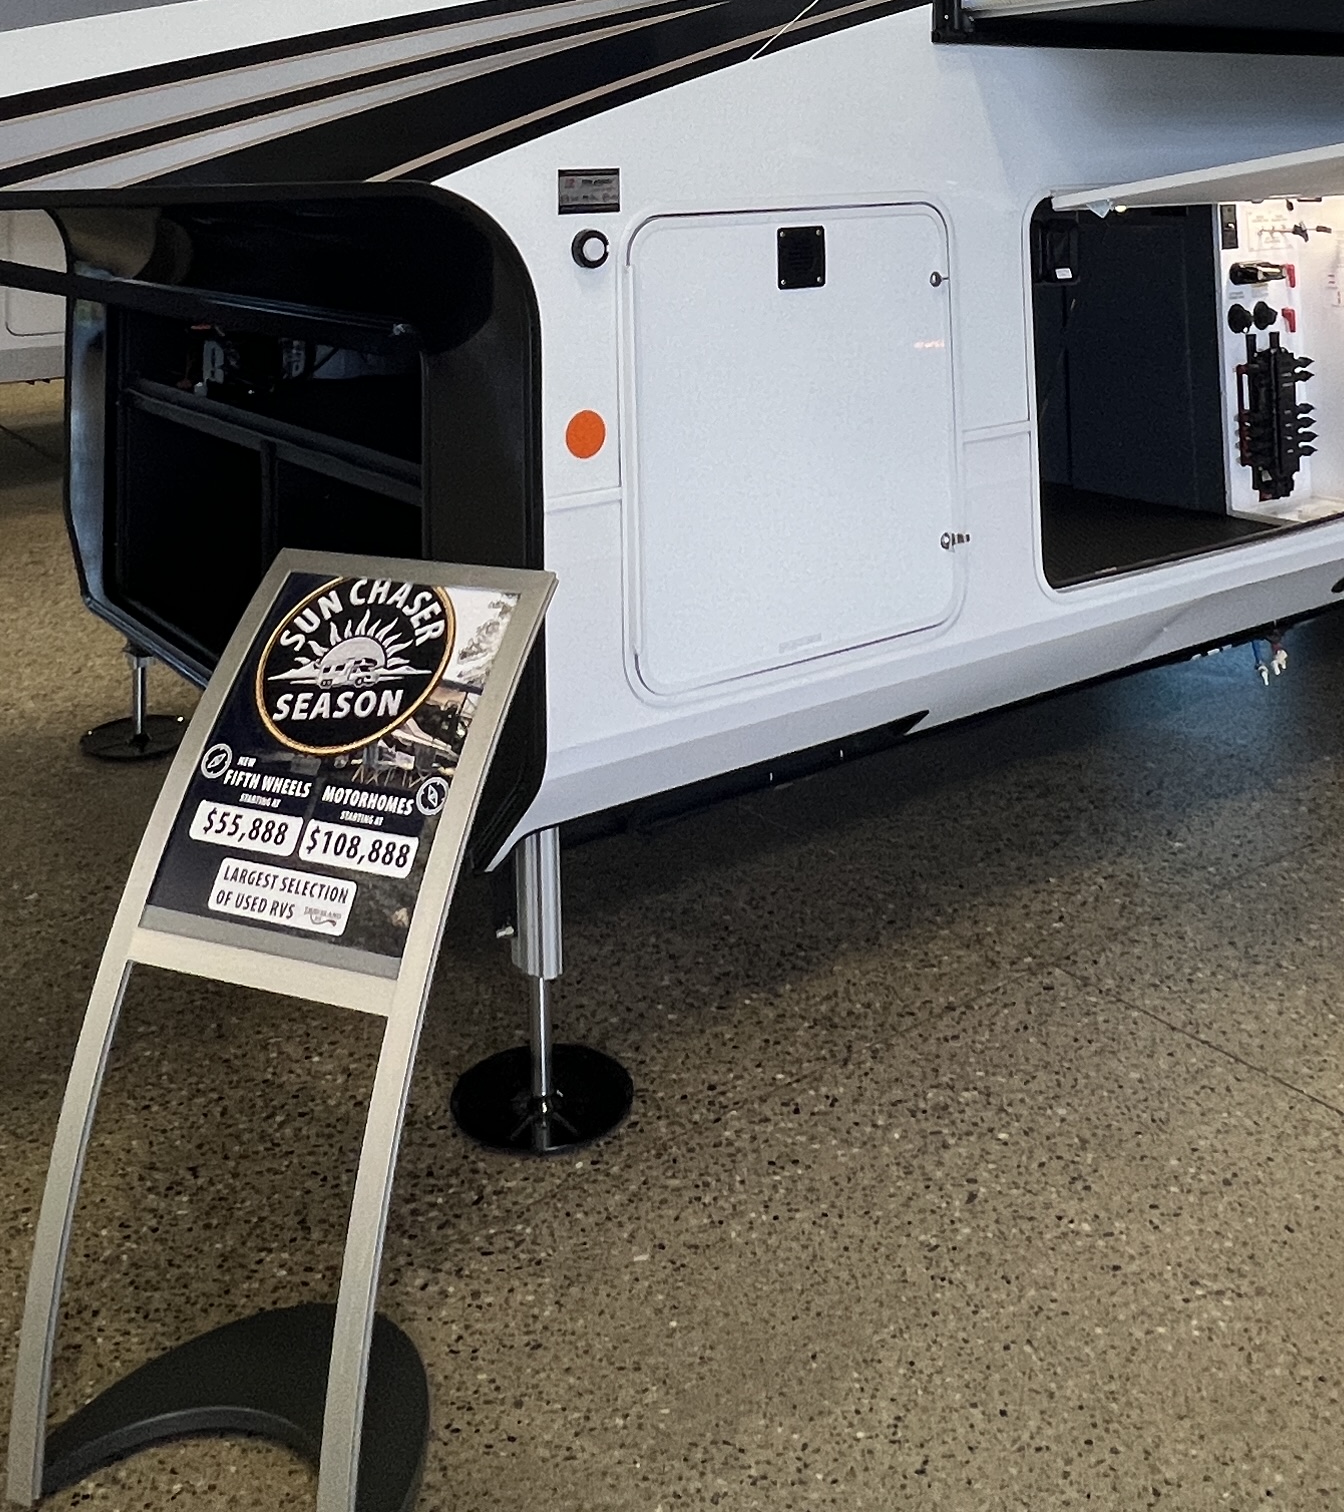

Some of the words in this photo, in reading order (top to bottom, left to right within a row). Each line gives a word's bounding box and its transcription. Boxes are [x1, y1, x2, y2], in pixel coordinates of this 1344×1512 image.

[280, 590, 343, 651] SUN
[349, 577, 446, 646] CHASER
[273, 689, 404, 721] SEASON
[237, 756, 256, 767] NEW
[223, 769, 261, 790] FIFTH
[261, 774, 313, 798] WHEELS
[321, 785, 415, 816] MOTORHOMES
[203, 807, 289, 845] $55,888
[339, 810, 374, 824] STARTING
[306, 825, 410, 868] $108,888
[223, 865, 279, 889] LARGEST
[279, 876, 349, 904] SELECTION
[216, 890, 233, 906] OF
[235, 892, 267, 913] USED
[269, 900, 295, 919] RVS
